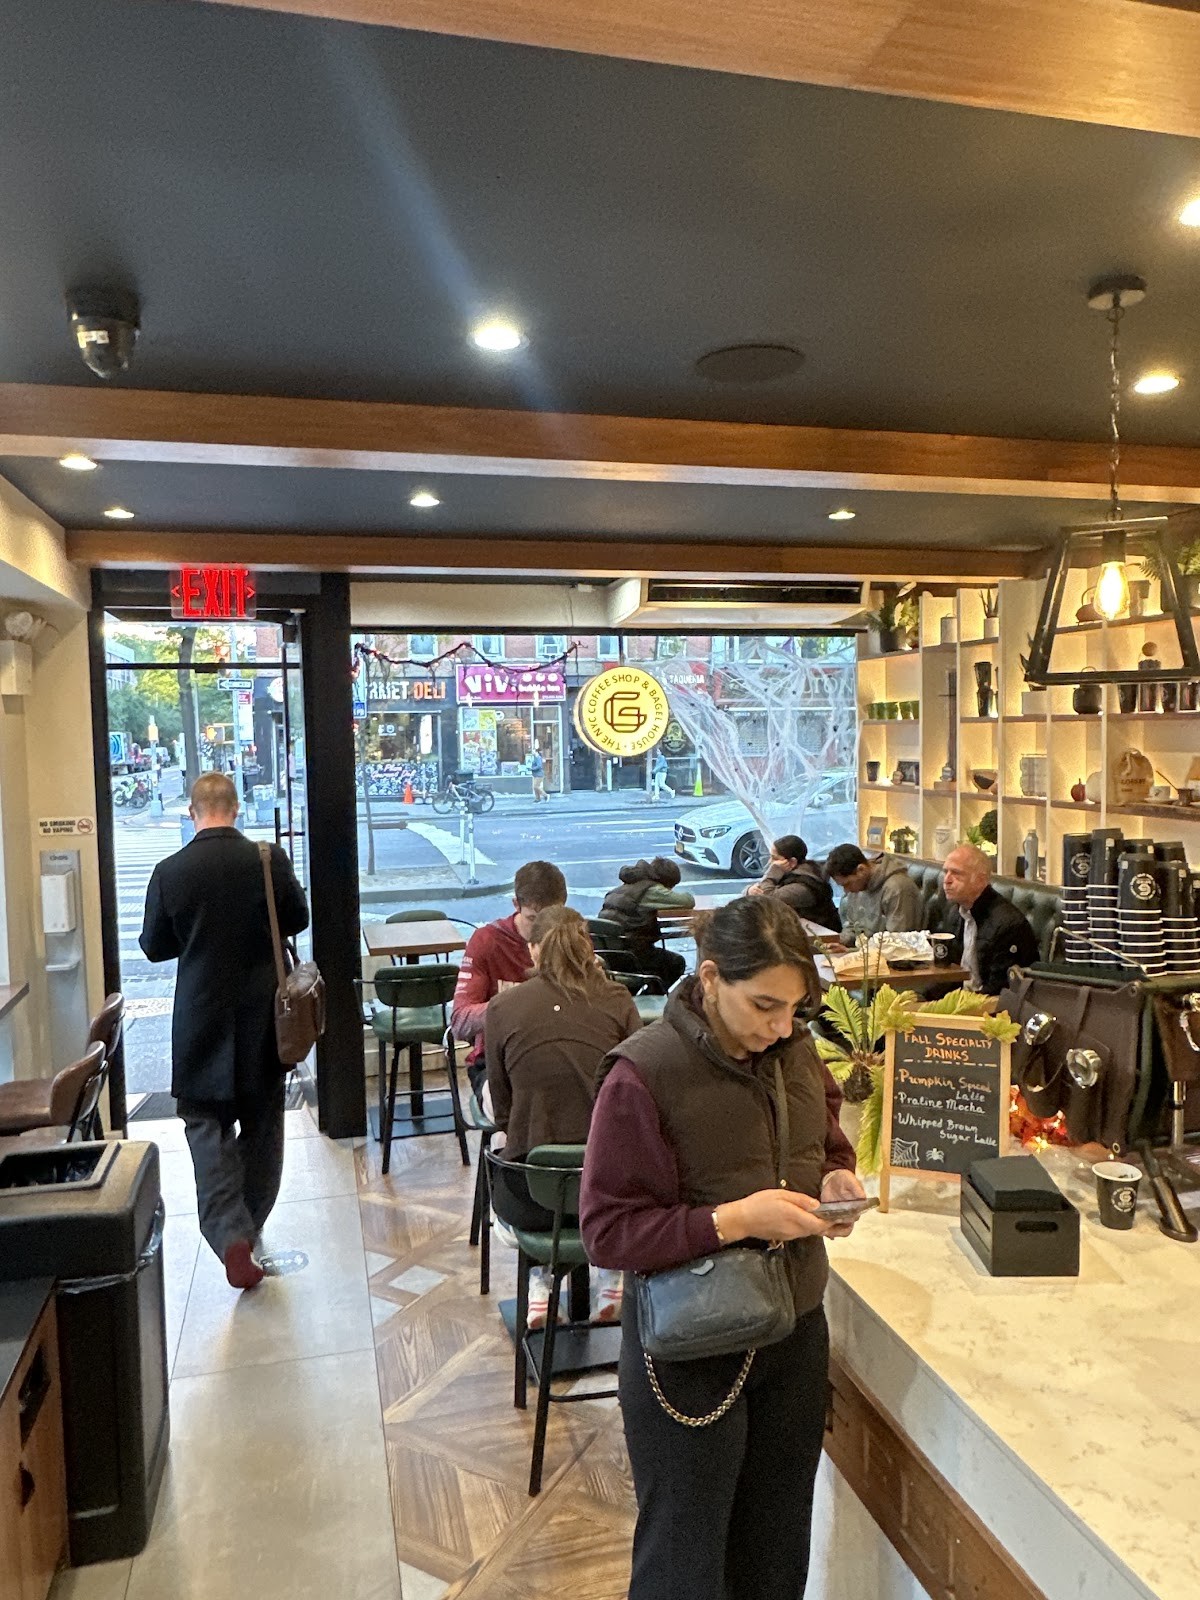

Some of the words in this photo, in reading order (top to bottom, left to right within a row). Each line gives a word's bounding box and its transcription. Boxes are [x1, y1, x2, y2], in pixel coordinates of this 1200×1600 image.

[182, 569, 249, 617] EXIT
[612, 674, 640, 684] SHOP
[641, 680, 649, 690] &
[413, 681, 446, 699] DELI
[588, 678, 611, 714] COFFEE
[648, 689, 663, 721] BAGEL
[589, 717, 602, 737] NYC
[631, 724, 659, 750] HOUSE
[601, 735, 621, 750] THE
[904, 1032, 932, 1045] FALL
[935, 1032, 993, 1049] SPECIALTY
[924, 1046, 970, 1061] DRINKS
[898, 1068, 956, 1090] Pumpkin
[897, 1091, 943, 1109] Praline
[945, 1098, 985, 1114] Mocha
[897, 1112, 943, 1129] Whipped
[946, 1119, 978, 1134] Brown
[939, 1129, 971, 1145] Sugar
